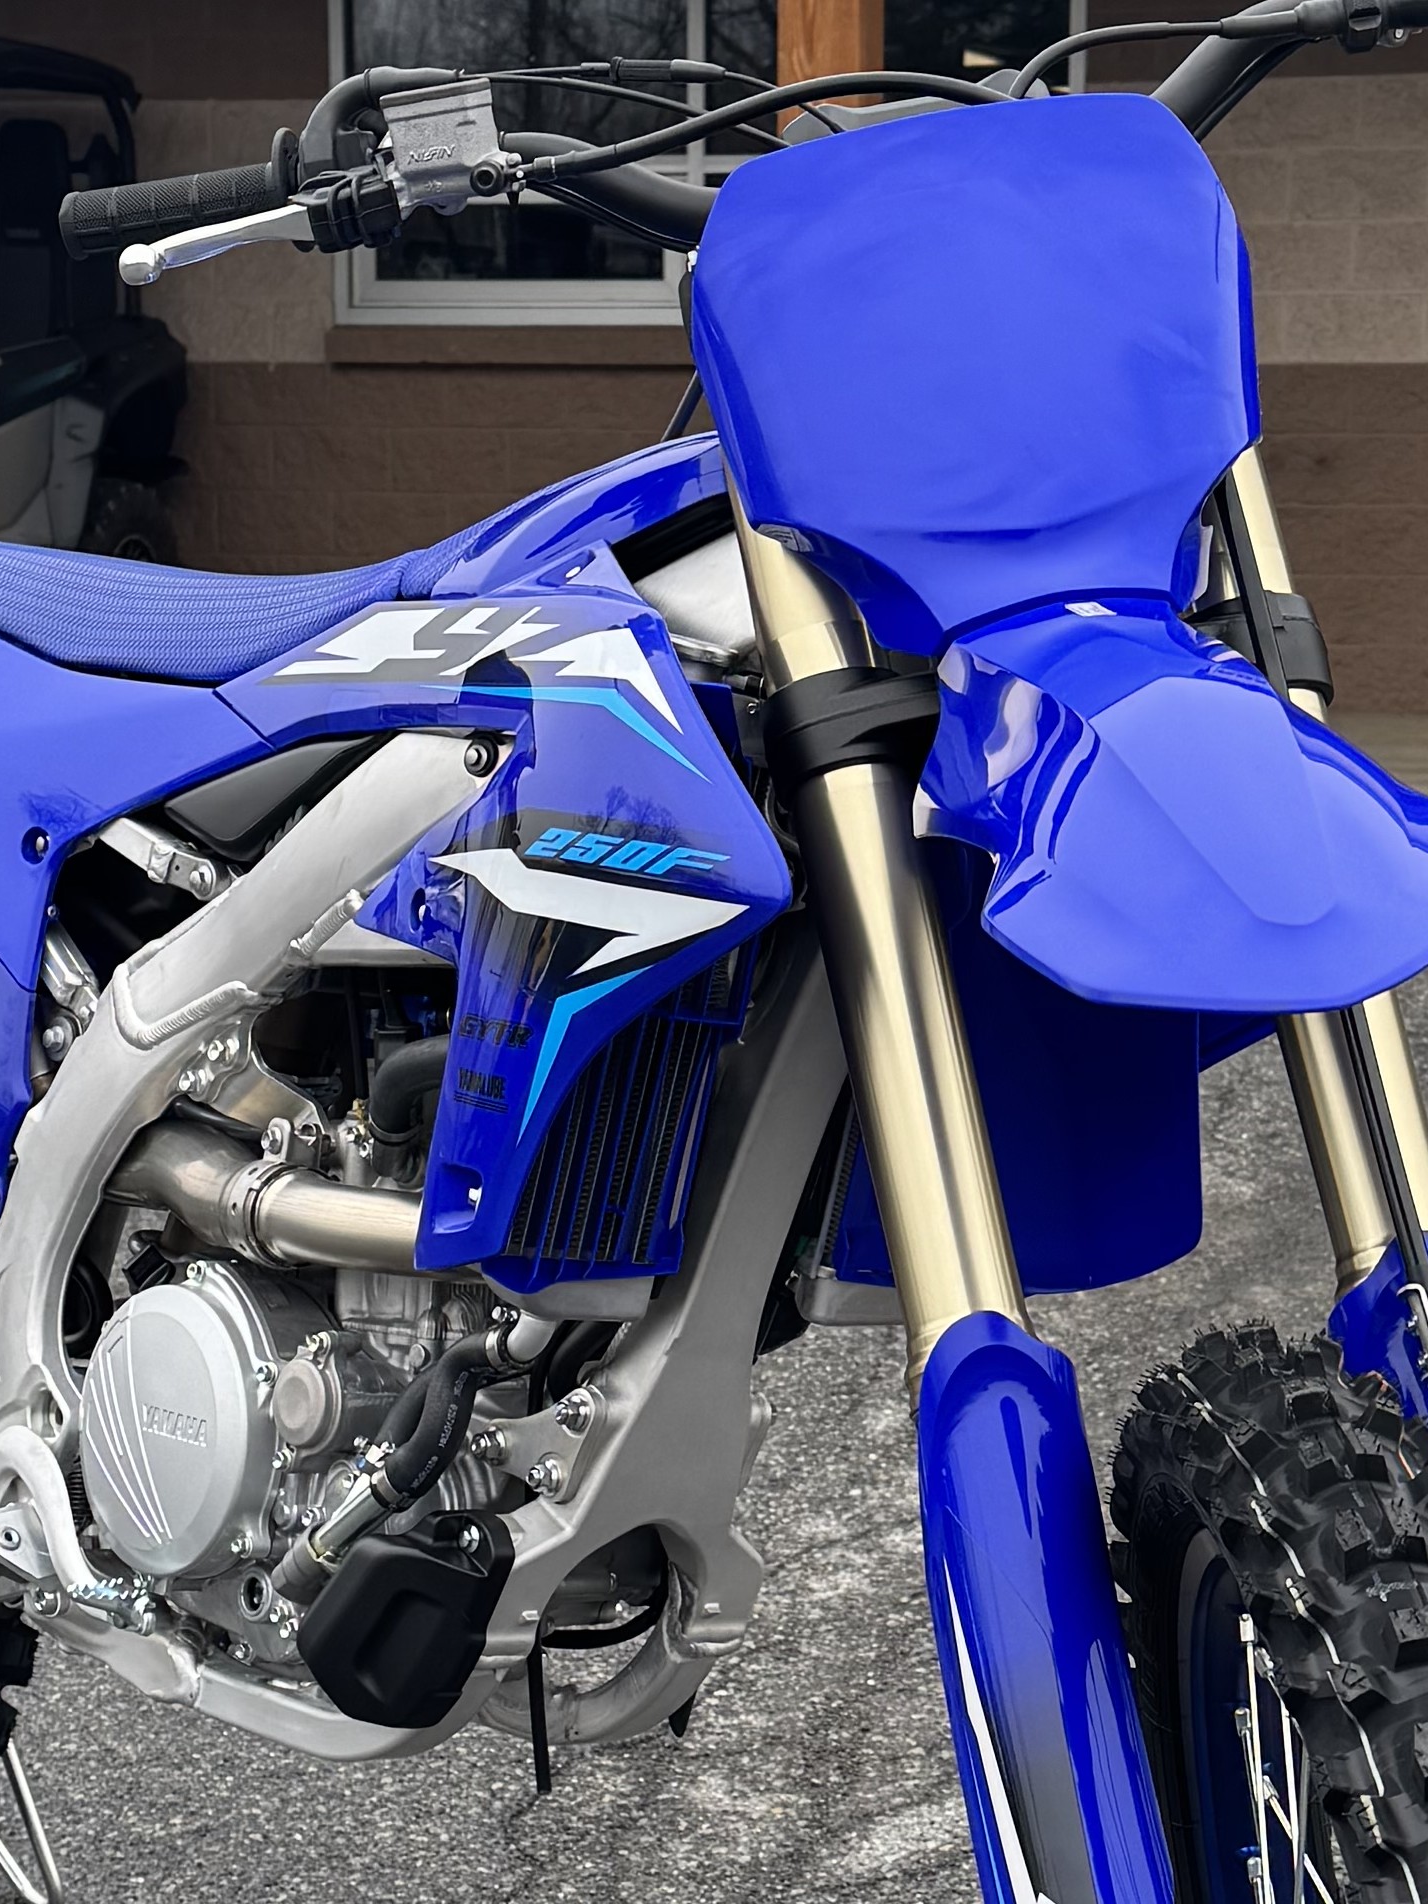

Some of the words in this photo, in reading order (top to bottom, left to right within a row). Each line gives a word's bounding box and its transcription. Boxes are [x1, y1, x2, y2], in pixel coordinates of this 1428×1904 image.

[524, 827, 732, 876] 250F
[459, 1012, 534, 1048] GYTR
[141, 1403, 208, 1448] YAMAHA
